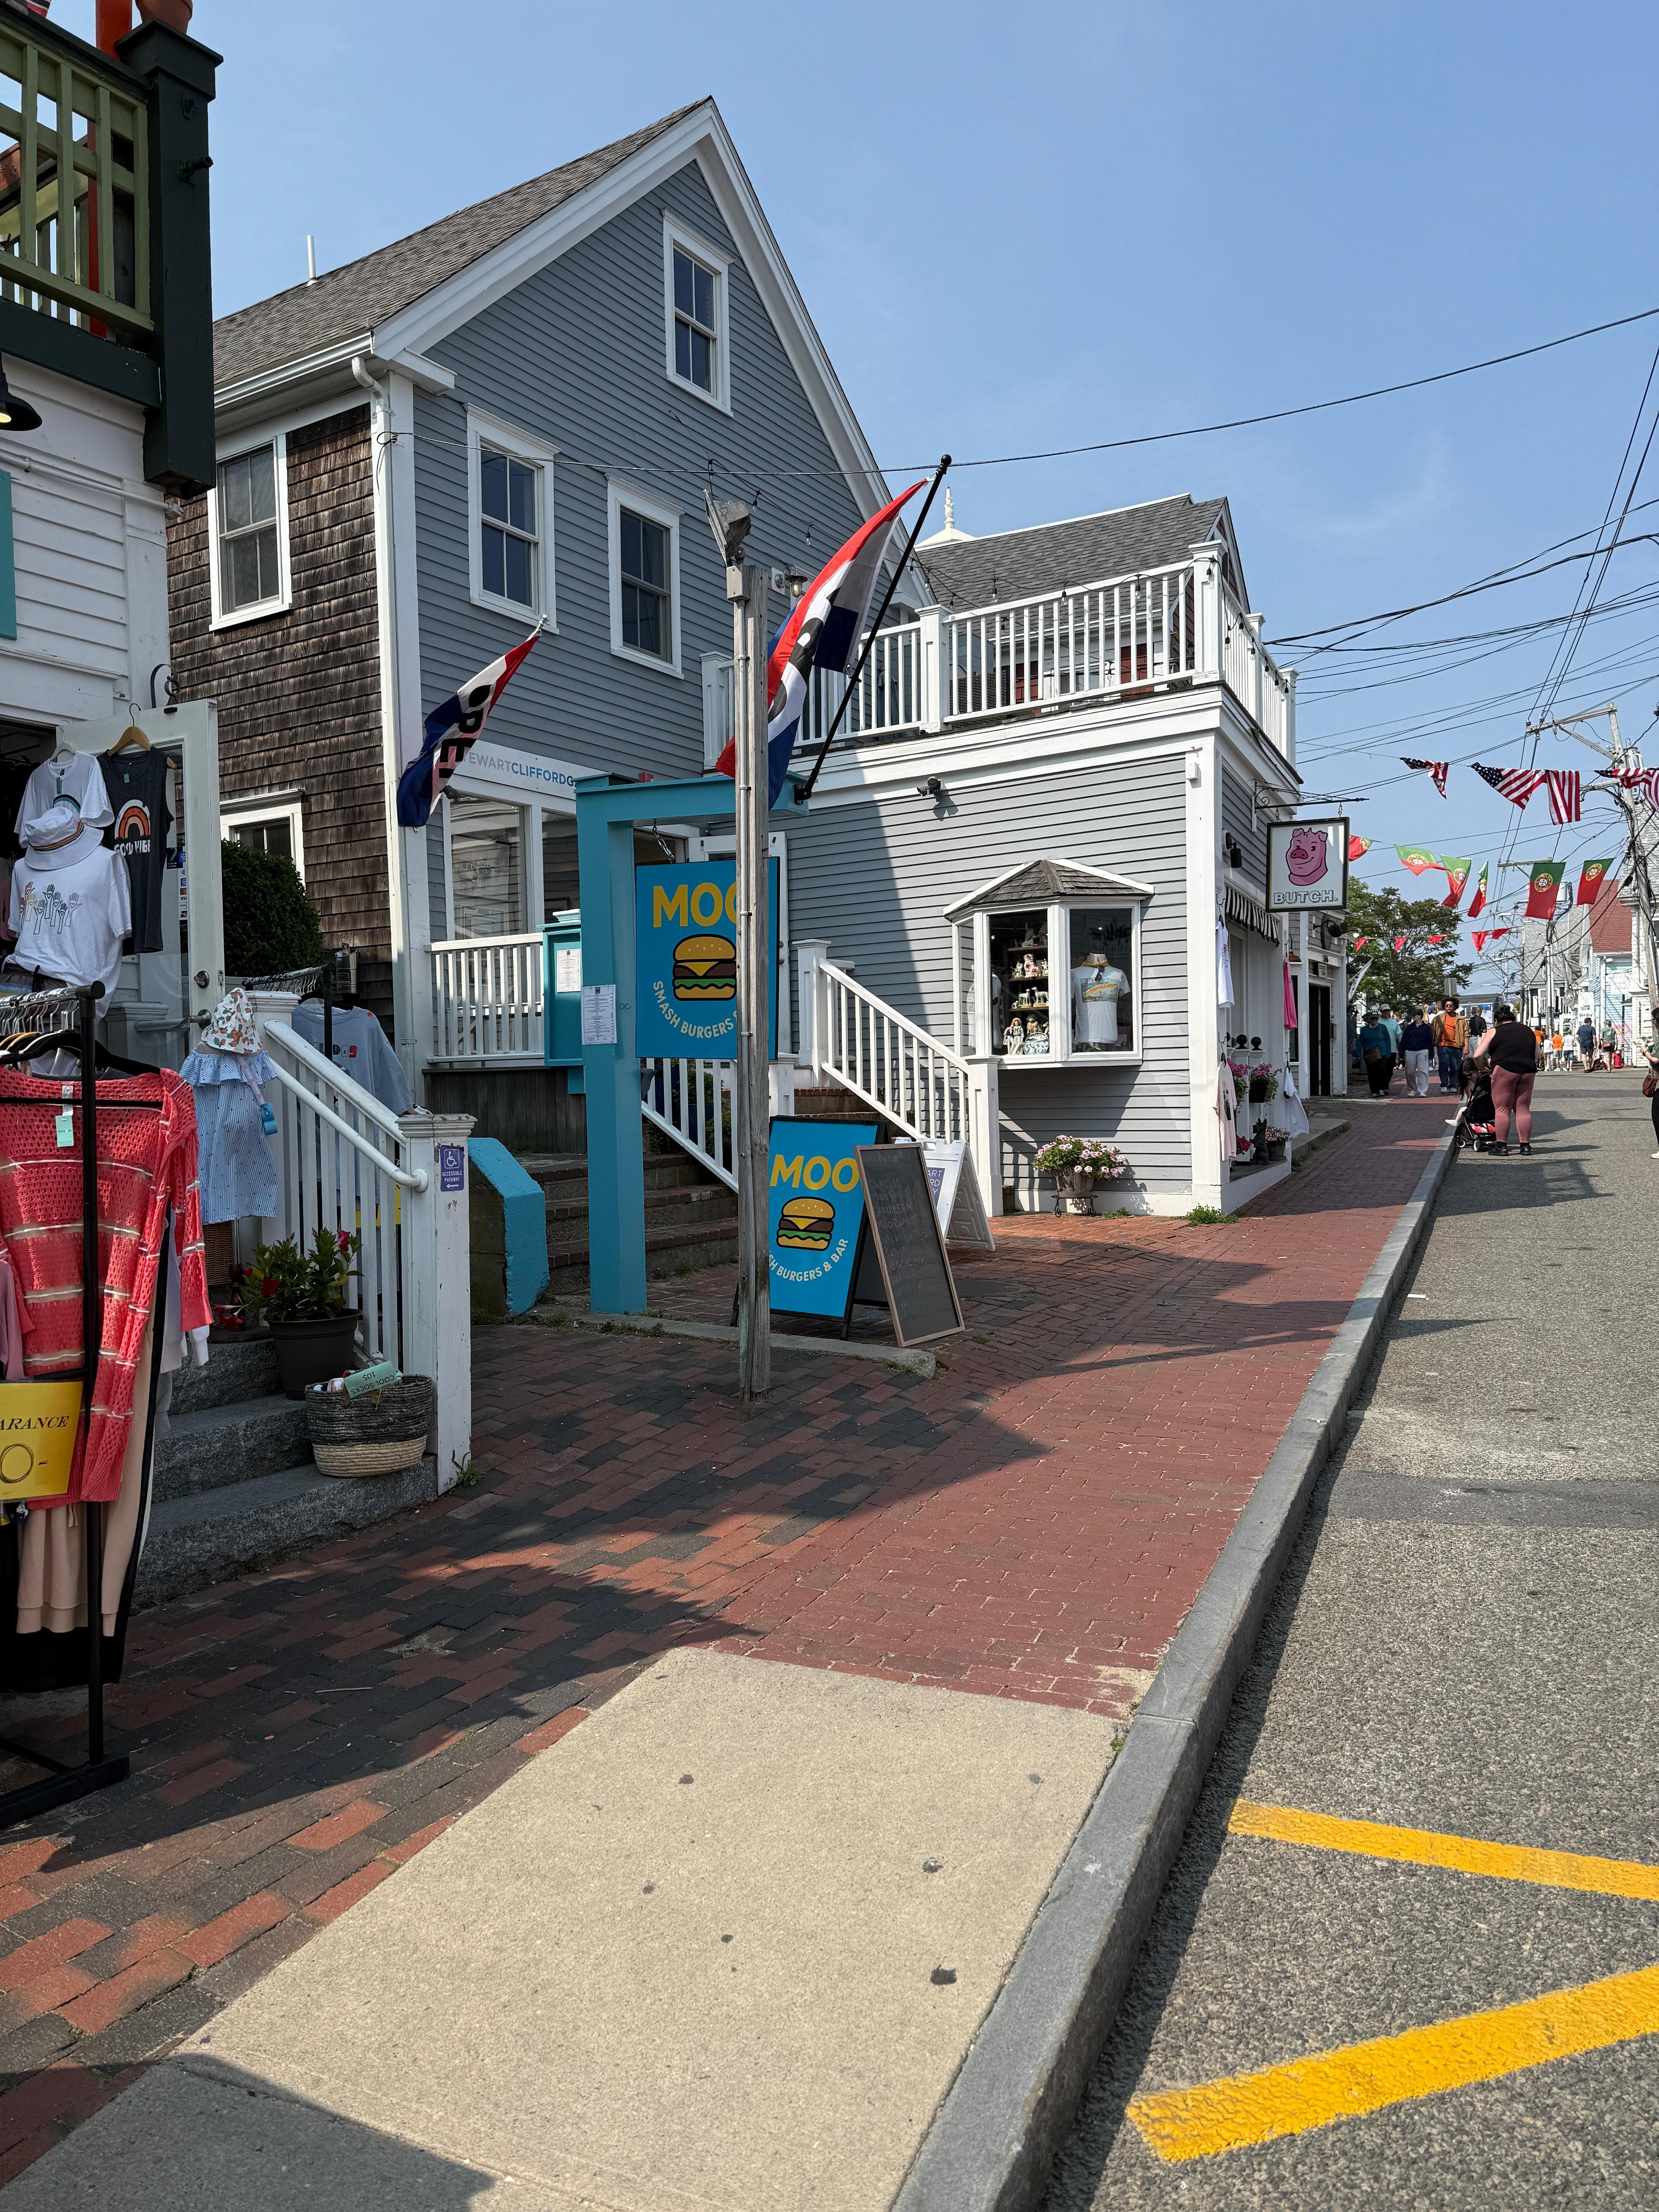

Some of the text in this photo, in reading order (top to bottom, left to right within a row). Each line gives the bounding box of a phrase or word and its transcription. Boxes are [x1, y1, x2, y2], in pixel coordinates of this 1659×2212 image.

[464, 752, 574, 787] EWARTCLIFFORDG
[1274, 890, 1338, 904] BUTCH.
[653, 981, 681, 1028] SMASH
[680, 1018, 734, 1038] BURGERS
[770, 1154, 860, 1192] MOO
[776, 1266, 822, 1282] BURGERS
[823, 1261, 832, 1272] &
[831, 1239, 848, 1263] BAR
[351, 1375, 395, 1395] COOL SOCKS
